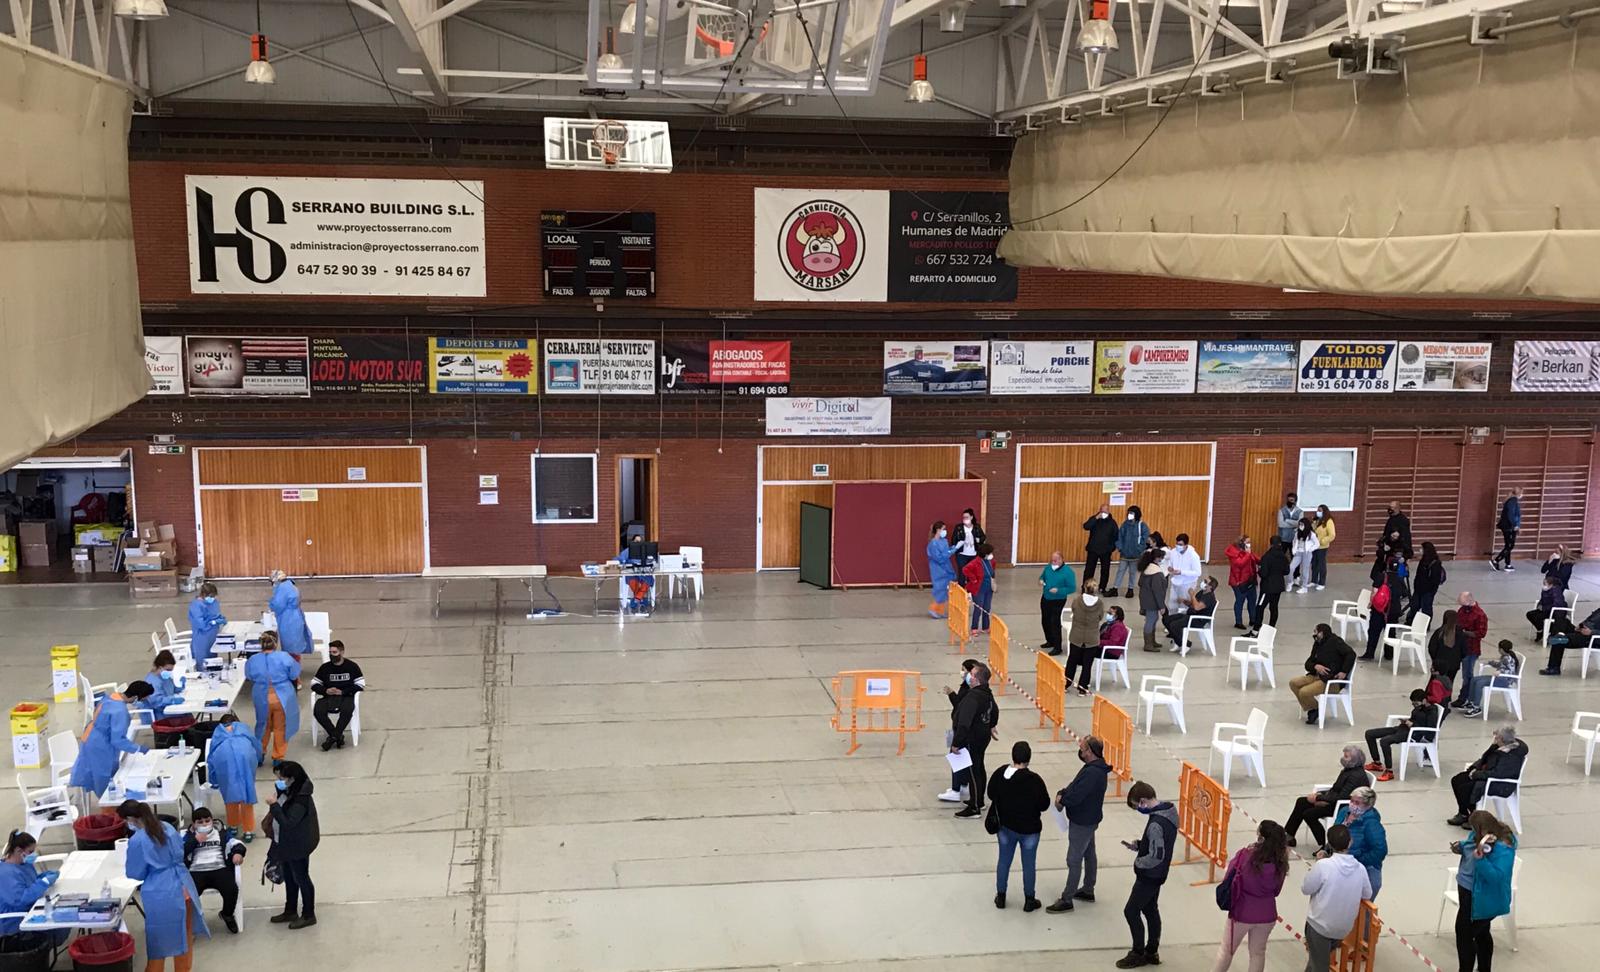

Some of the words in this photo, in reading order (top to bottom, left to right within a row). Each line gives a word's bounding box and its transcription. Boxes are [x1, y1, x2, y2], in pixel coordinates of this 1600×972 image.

[292, 201, 365, 214] SERRANO
[370, 203, 443, 215] BUILDING
[447, 204, 475, 216] S.L.
[922, 212, 935, 223] C/
[937, 212, 992, 224] Serranillos,
[995, 213, 1002, 222] 2
[317, 224, 451, 235] www.proyectosserrano.com
[902, 225, 952, 236] Humanes
[954, 226, 968, 236] de
[547, 235, 578, 244] LOCAL
[621, 236, 651, 245] VISITANTE
[290, 241, 479, 254] administracion@proyectosserrano.com
[926, 254, 946, 265] 667
[949, 254, 969, 265] 532
[972, 254, 993, 265] 724
[297, 264, 322, 276] 647
[323, 264, 339, 276] 52
[341, 265, 358, 276] 90
[361, 265, 377, 276] 39
[395, 266, 408, 277] 91
[410, 266, 436, 277] 425
[438, 266, 454, 277] 84
[456, 266, 471, 277] 67
[794, 268, 850, 288] MARSAN
[909, 275, 945, 283] REPARTO
[946, 275, 953, 283] A
[954, 275, 997, 283] DOMICILIO
[552, 288, 574, 296] FALTAS
[625, 289, 648, 297] FALTAS
[446, 339, 495, 348] DEPORTES
[499, 340, 519, 348] FIFA
[547, 342, 601, 355] CERRAJERIA
[1203, 344, 1233, 352] VIAJES
[712, 350, 764, 361] ABOGADOS
[1066, 346, 1076, 355] EL
[1325, 345, 1386, 355] TOLDOS
[583, 359, 610, 368] PUERTAS
[1050, 356, 1090, 366] PORCHE
[1311, 356, 1383, 369] FUENLABRADA
[1541, 359, 1584, 373] Berkan
[312, 359, 346, 381] LOED
[348, 359, 394, 381] MOTOR
[397, 360, 423, 381] SUR
[602, 370, 612, 380] 91
[614, 370, 629, 380] 604
[631, 370, 640, 380] 87
[643, 370, 653, 381] 17
[661, 355, 686, 388] bfr
[738, 386, 748, 395] 91
[750, 386, 765, 395] 694
[1300, 381, 1315, 390] tel:
[1317, 380, 1330, 390] 91
[1333, 380, 1355, 390] 604
[1358, 380, 1372, 390] 70
[1374, 380, 1389, 390] 88
[815, 399, 859, 416] Digital
